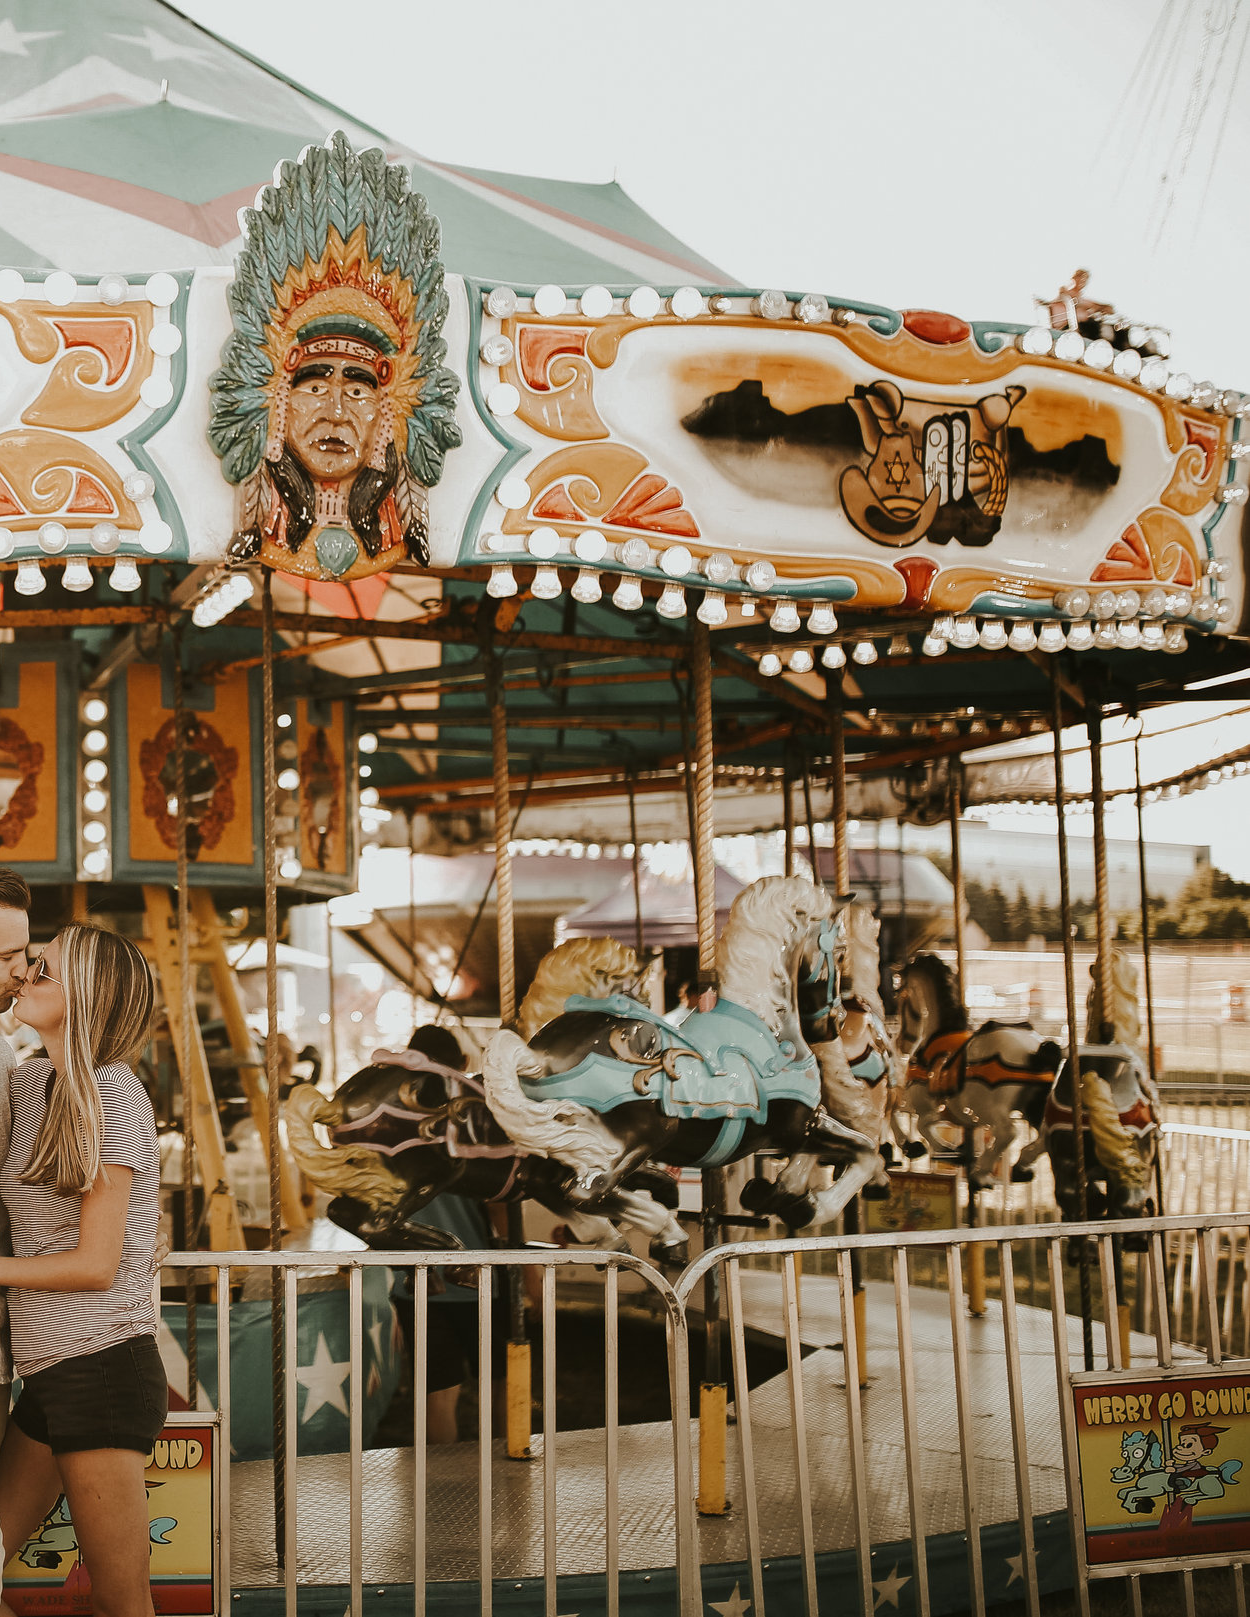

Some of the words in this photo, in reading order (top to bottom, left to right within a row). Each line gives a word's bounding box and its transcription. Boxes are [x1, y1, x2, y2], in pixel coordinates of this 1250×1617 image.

[1083, 1395, 1153, 1425] MERRY
[1158, 1391, 1186, 1420] GO
[144, 1439, 204, 1469] UND
